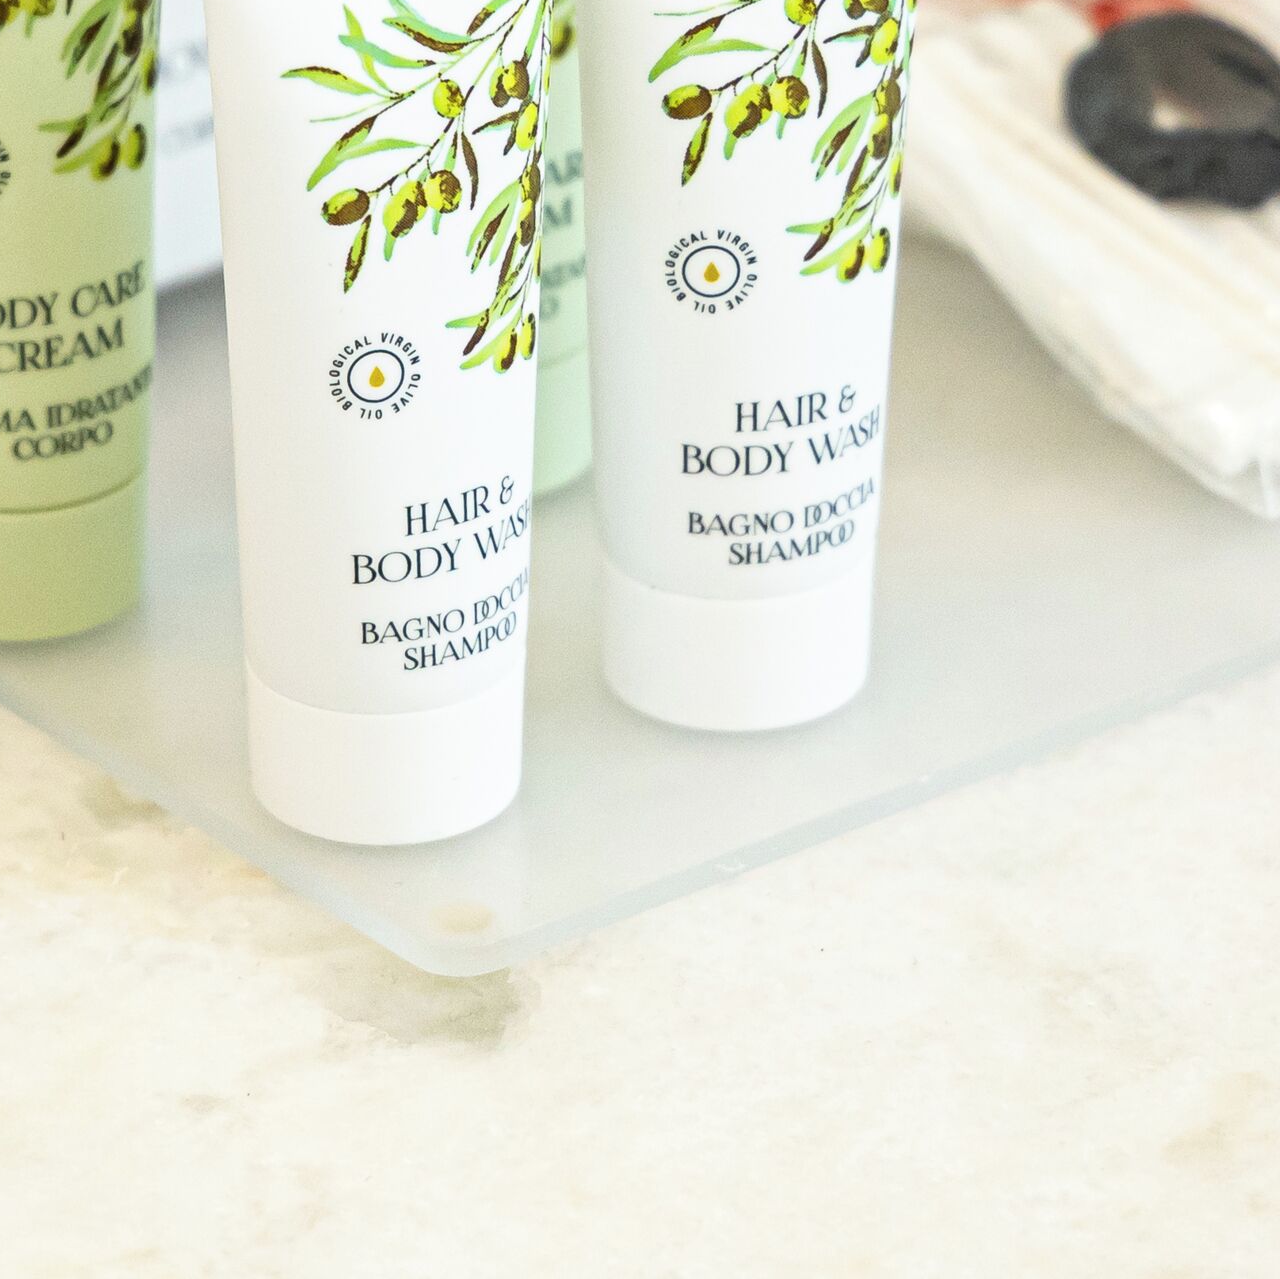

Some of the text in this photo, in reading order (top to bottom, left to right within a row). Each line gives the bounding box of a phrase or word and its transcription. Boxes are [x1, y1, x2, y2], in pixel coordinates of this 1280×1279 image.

[71, 259, 144, 318] CARE
[665, 229, 758, 314] BIOLOGICAL VIRGIN OLIVE OIL
[328, 332, 421, 420] BIOLOGICAL VIRGIN OLIVE OIL
[734, 384, 857, 433] HAIR &
[12, 420, 114, 461] CORPO
[681, 404, 881, 477] BODY WASH
[404, 475, 515, 537] HAIR &
[688, 477, 876, 537] BAGNO DOCCIA
[351, 494, 531, 585] BODY WASH
[729, 519, 855, 566] SHAMPOO
[361, 609, 465, 645] BAGNO
[403, 611, 517, 671] SHAMPOO
